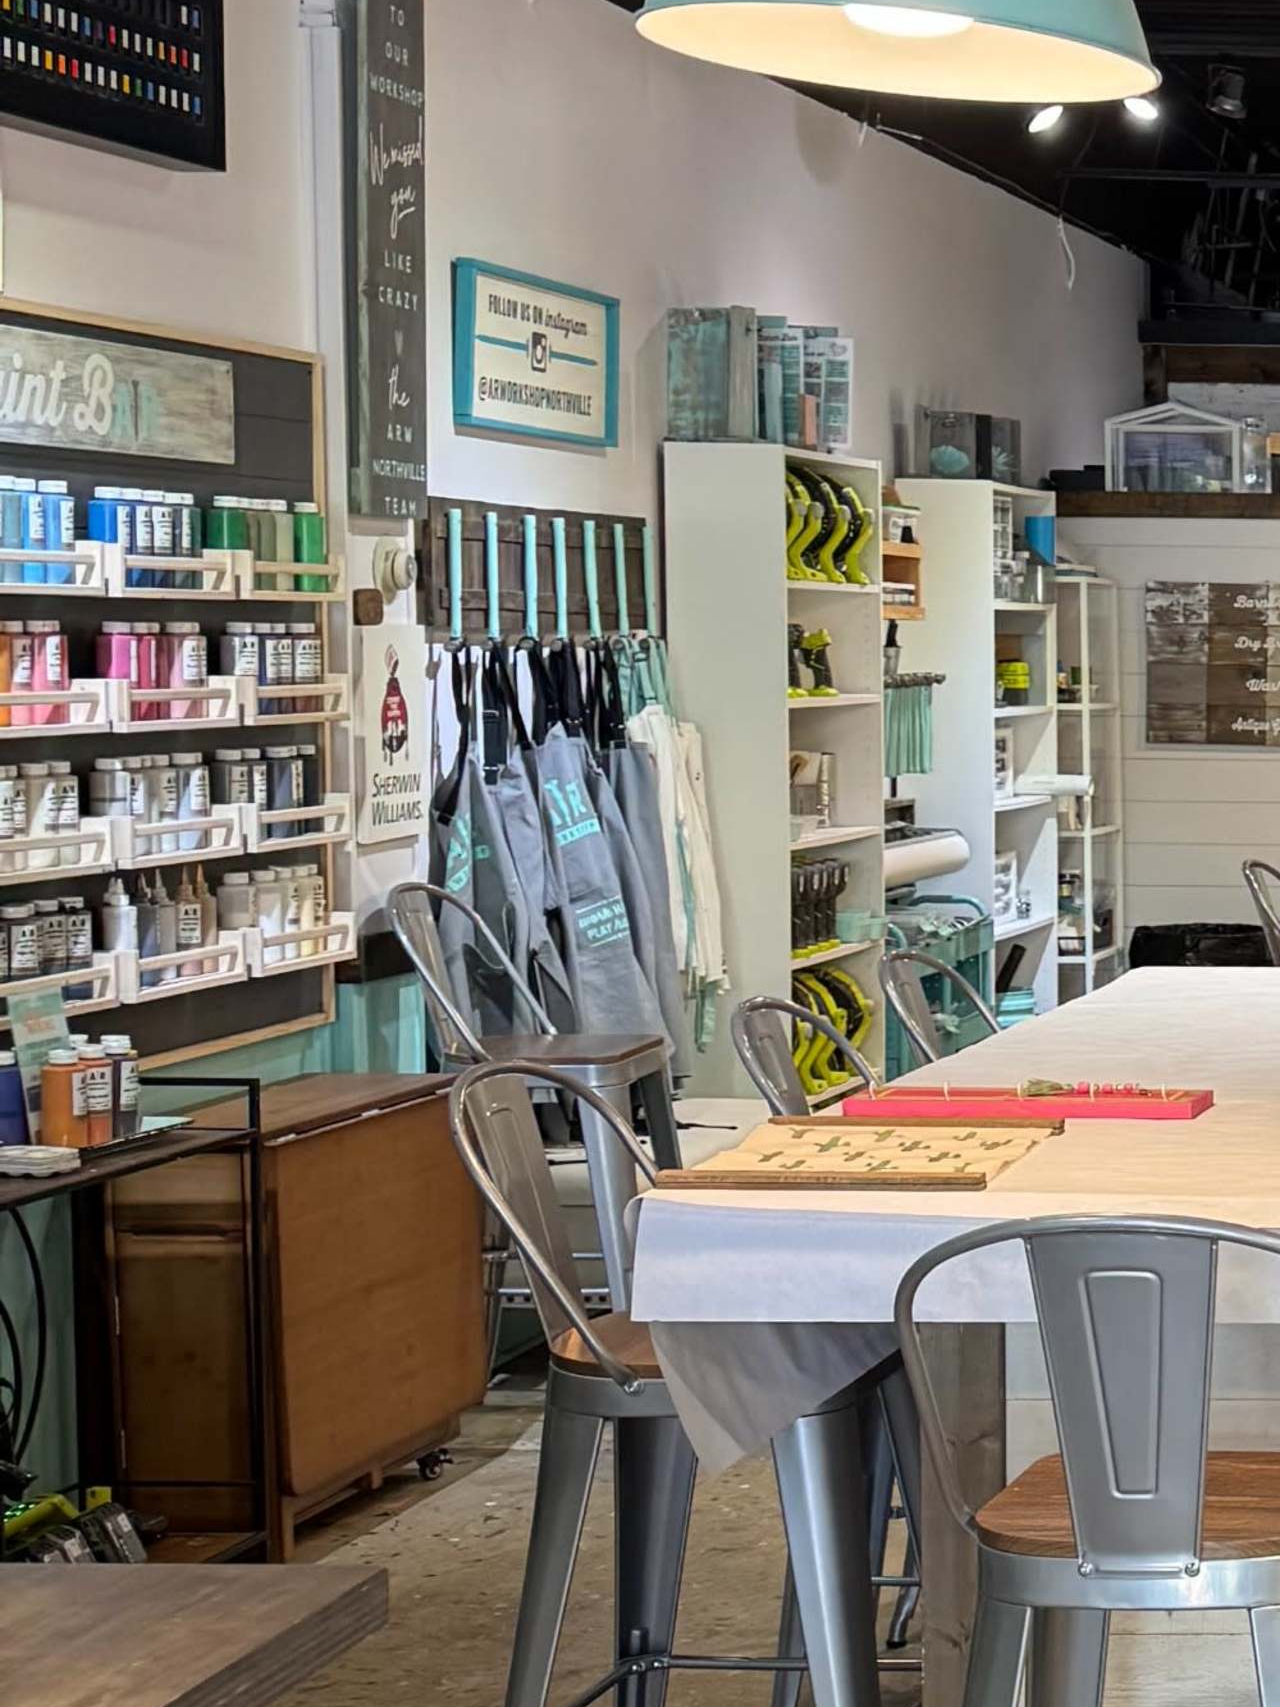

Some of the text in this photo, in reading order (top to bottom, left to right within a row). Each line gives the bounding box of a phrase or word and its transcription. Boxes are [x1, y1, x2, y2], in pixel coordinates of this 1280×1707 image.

[390, 5, 405, 27] TO
[385, 41, 409, 67] OUR
[369, 74, 424, 109] WORKSHOP
[384, 249, 412, 274] LIKE
[378, 285, 418, 311] CRAZY
[488, 293, 588, 339] FOLLOW US ON instagram
[388, 363, 410, 410] the
[479, 376, 592, 417] @ARWORKSHOPNORTHVILLE
[372, 458, 426, 483] NORTHVILLE
[384, 496, 417, 517] TEAM
[1234, 635, 1262, 652] Dry
[372, 772, 421, 798] SHERWIN
